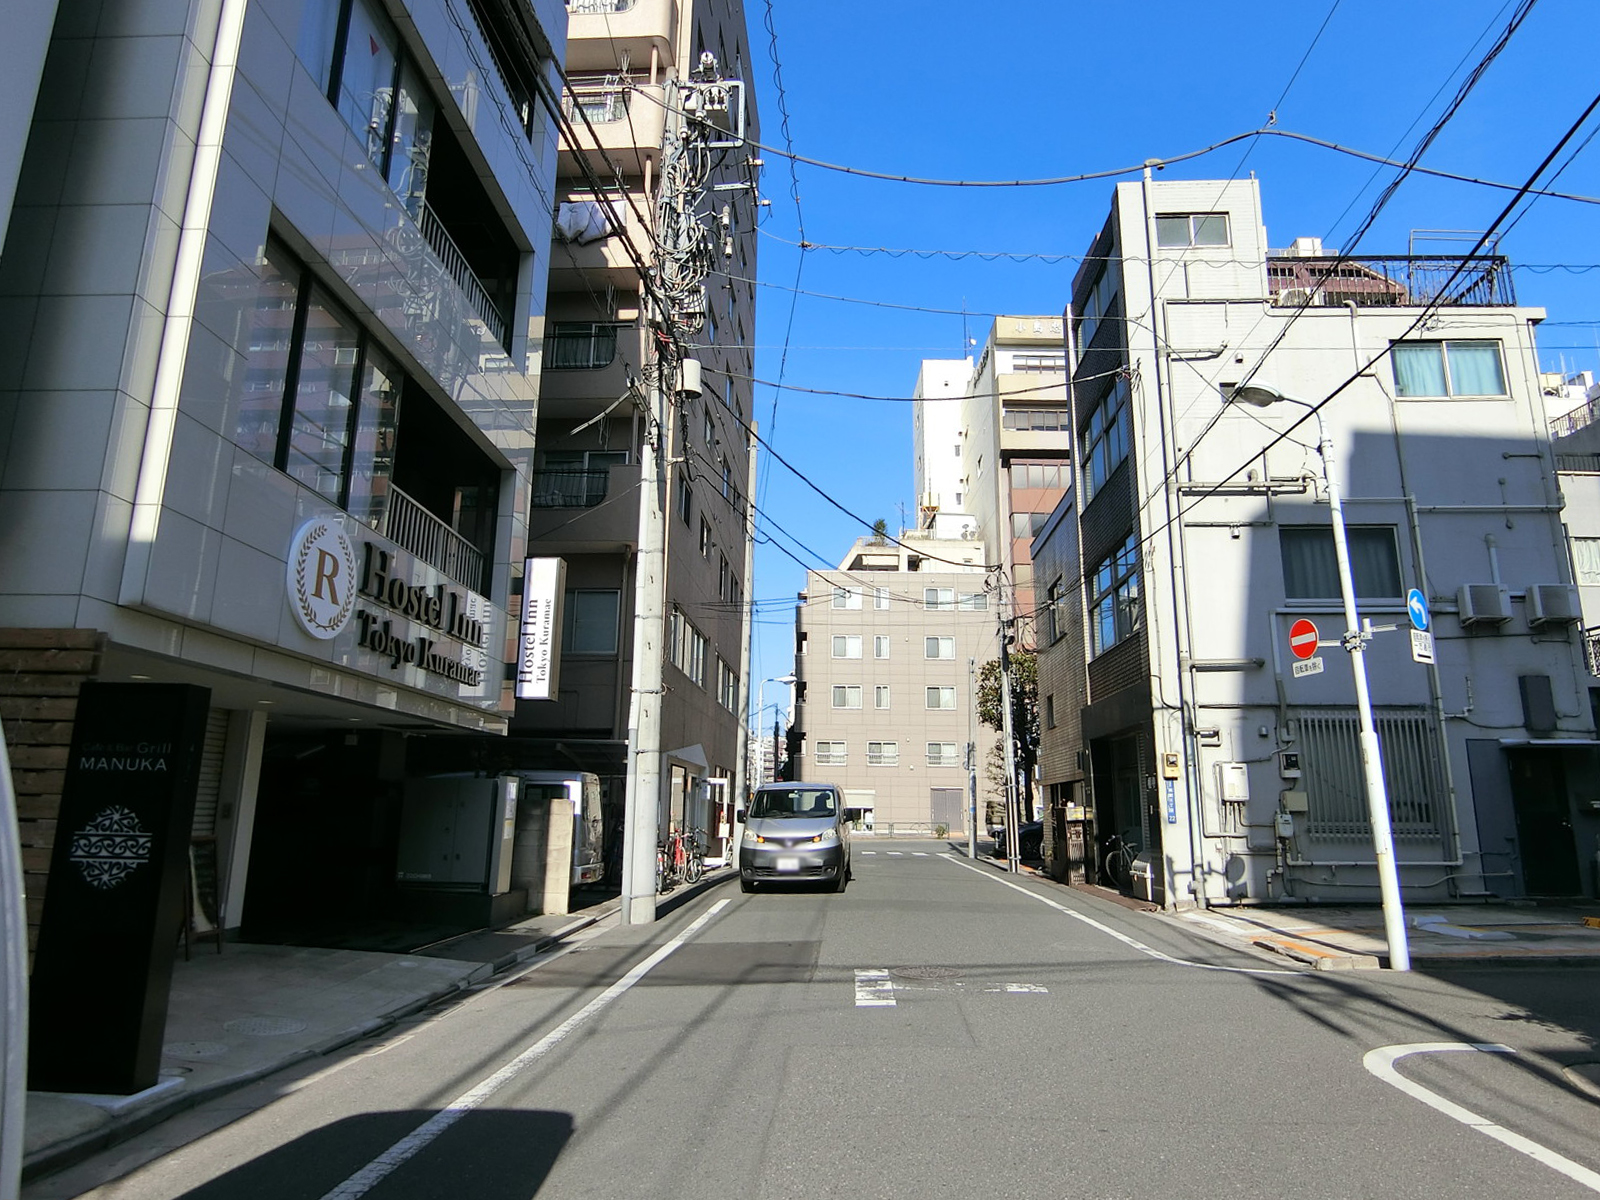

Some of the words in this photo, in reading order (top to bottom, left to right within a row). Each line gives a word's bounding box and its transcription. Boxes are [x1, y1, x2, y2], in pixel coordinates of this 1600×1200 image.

[311, 546, 341, 607] R
[359, 541, 447, 631] Hostel
[448, 591, 484, 649] Inn
[523, 599, 539, 626] Inn
[540, 599, 552, 646] Kuramae
[357, 609, 417, 670] Tokyo
[415, 636, 481, 687] Kuramae
[518, 632, 536, 684] Hostel
[536, 649, 551, 684] Tokyo
[80, 757, 167, 771] MANUKA
[137, 742, 172, 754] Grill
